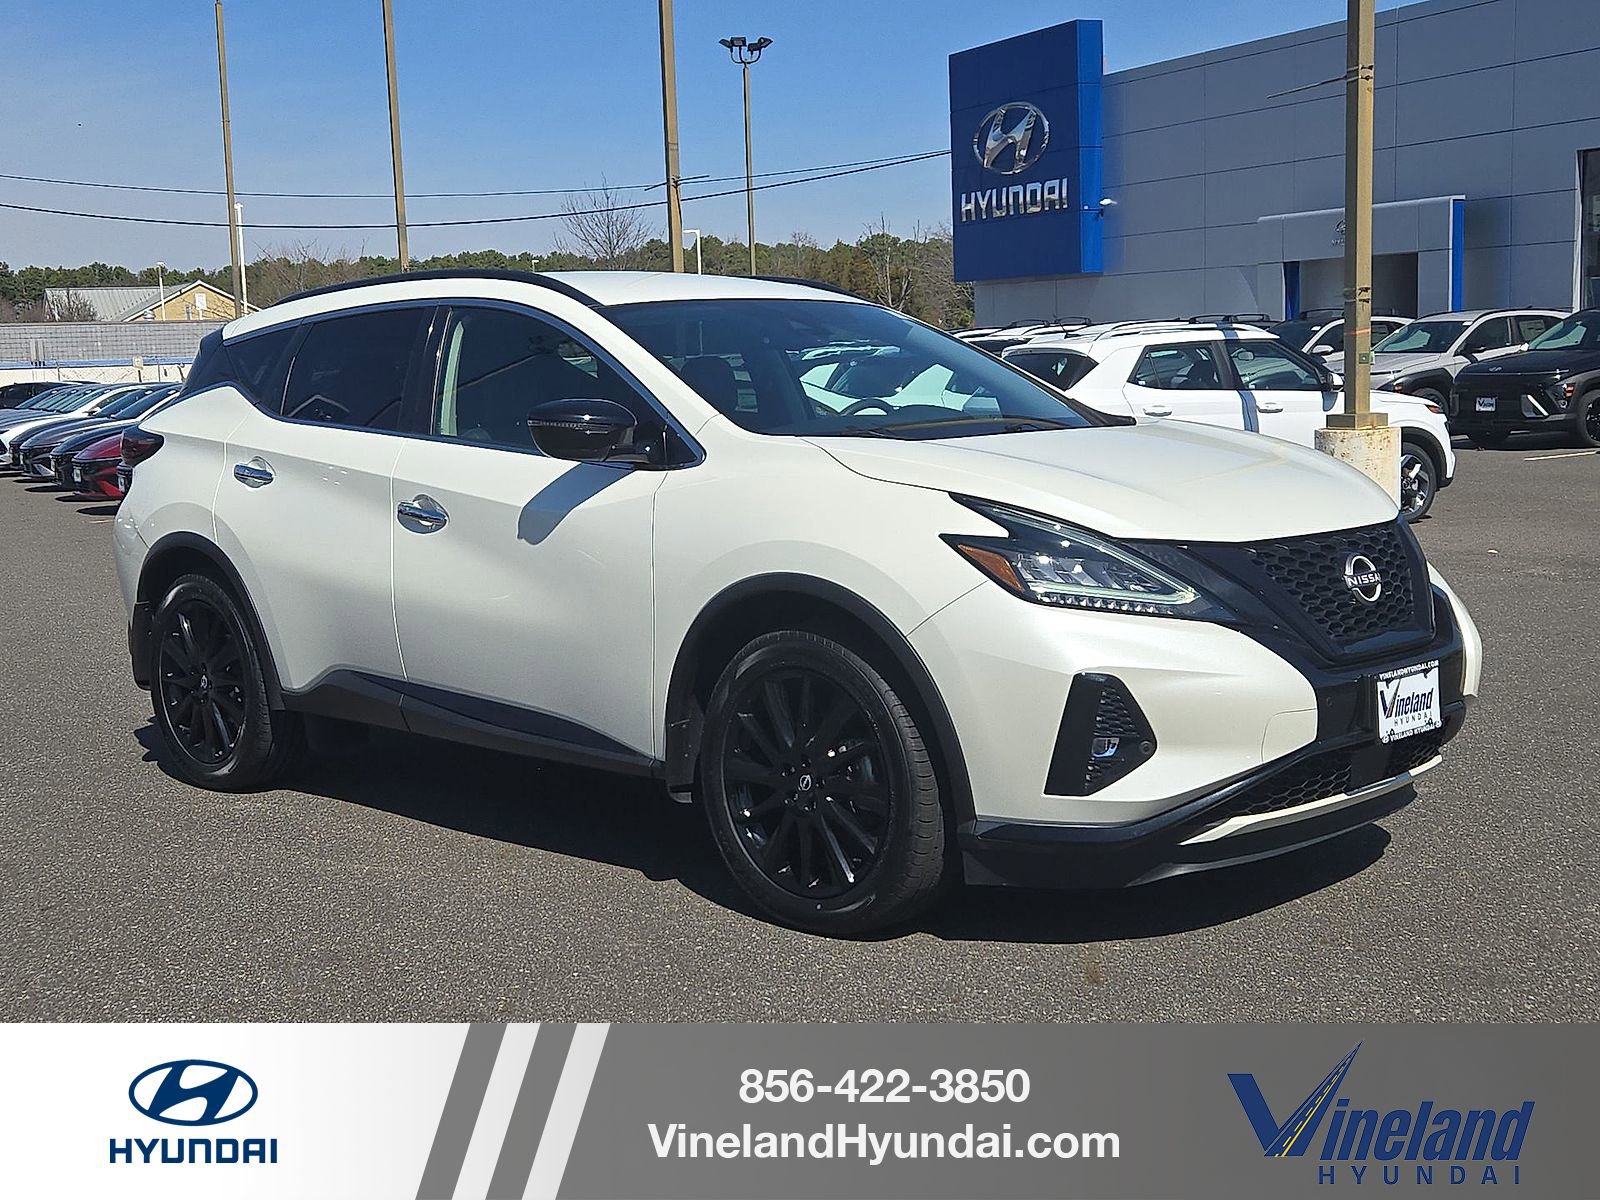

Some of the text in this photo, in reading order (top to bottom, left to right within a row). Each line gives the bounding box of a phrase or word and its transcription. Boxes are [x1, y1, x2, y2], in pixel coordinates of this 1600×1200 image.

[961, 177, 1068, 222] HYUNDAI
[1380, 679, 1434, 719] Vineland
[1394, 710, 1432, 727] HYUNDAI
